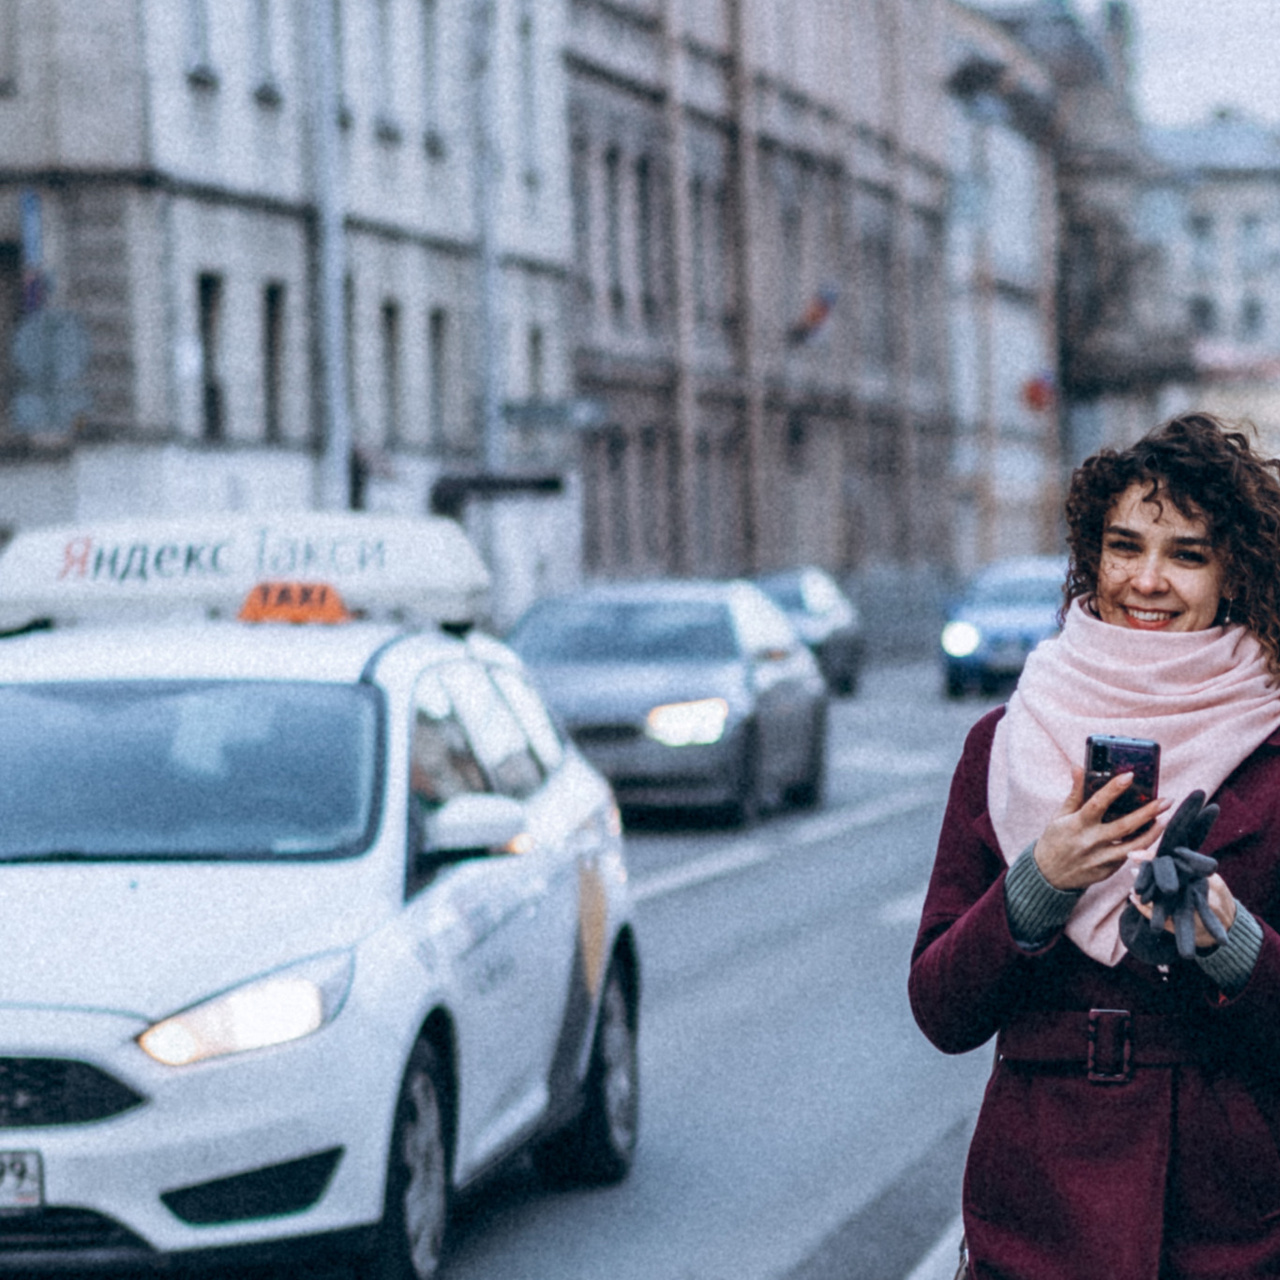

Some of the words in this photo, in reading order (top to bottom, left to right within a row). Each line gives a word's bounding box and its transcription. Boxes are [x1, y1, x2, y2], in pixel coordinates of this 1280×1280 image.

[57, 535, 234, 585] Яндекс
[254, 526, 387, 574] Такси
[259, 584, 329, 609] TAXI
